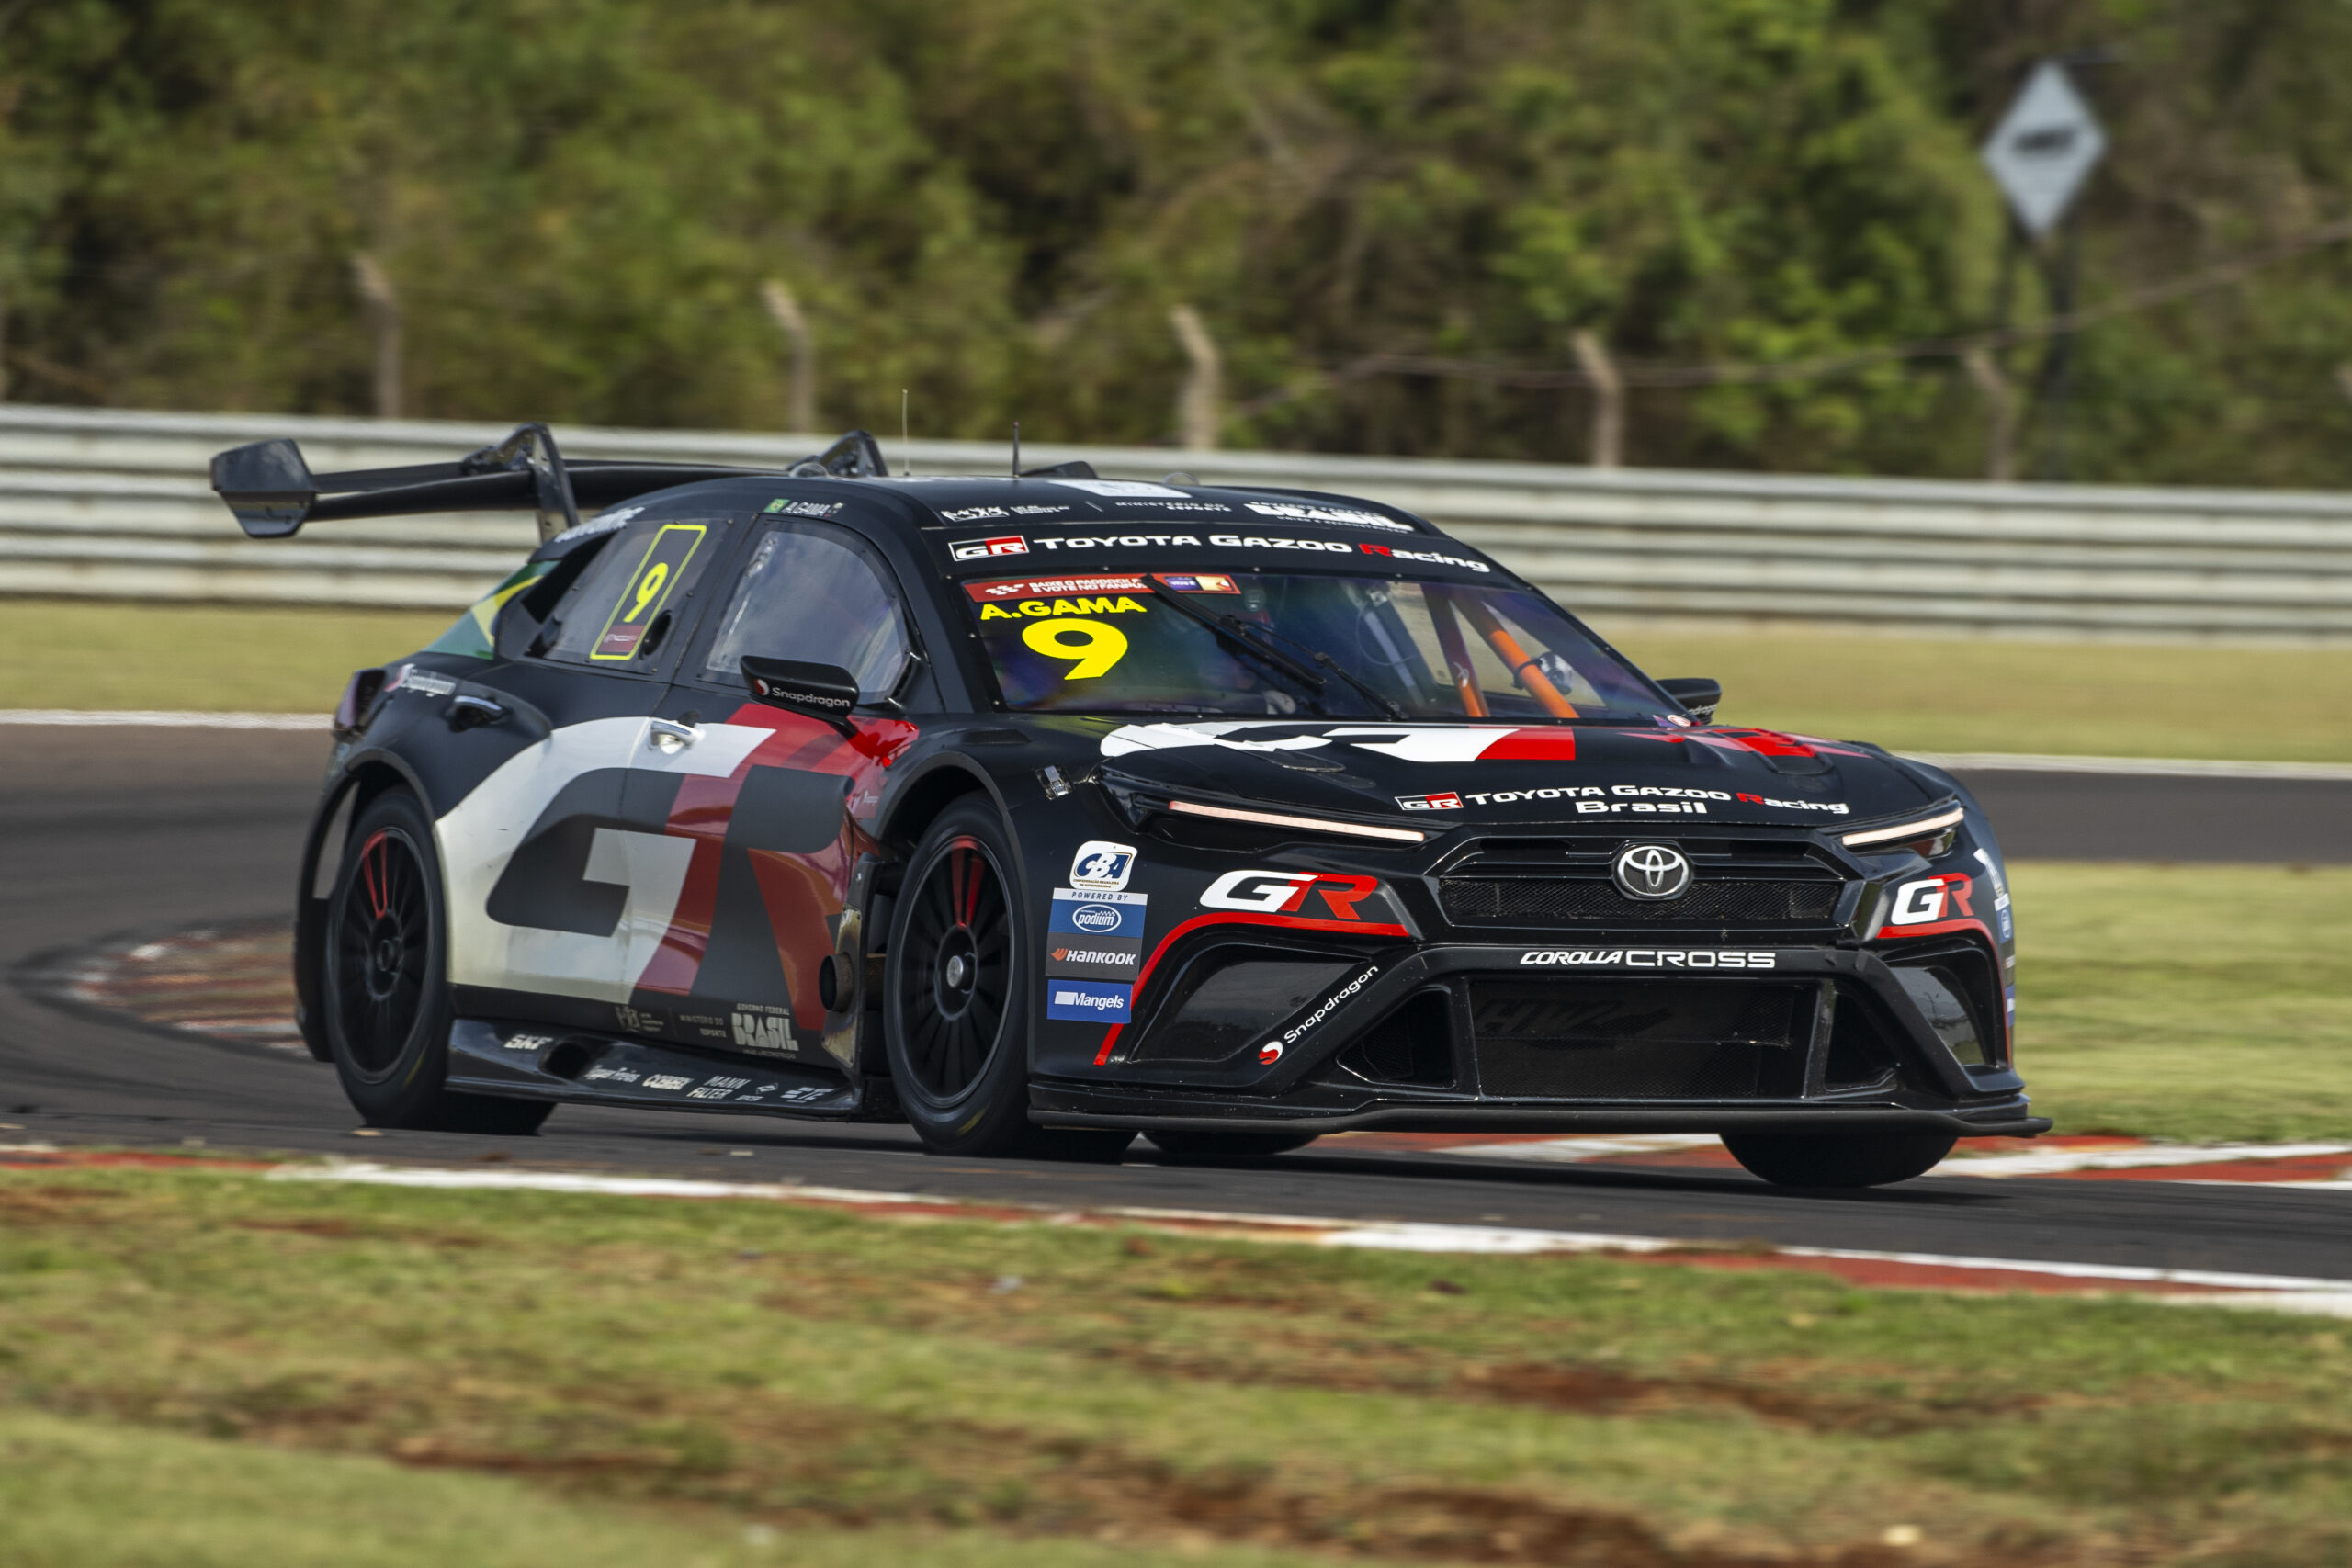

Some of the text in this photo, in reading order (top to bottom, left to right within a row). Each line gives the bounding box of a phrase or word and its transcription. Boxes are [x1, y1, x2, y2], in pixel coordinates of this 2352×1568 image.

[956, 542, 1028, 559] GR
[1033, 535, 1202, 549] TOYOTA
[1358, 543, 1491, 573] Racing
[622, 562, 669, 623] 9
[980, 597, 1148, 620] A.GAMA
[1022, 618, 1128, 681] 9
[772, 687, 851, 707] Snapdragon
[1465, 786, 1606, 805] TOYOTA
[1736, 792, 1850, 815] Racing
[1575, 801, 1708, 814] Brasil
[1076, 853, 1130, 879] CBA
[1071, 891, 1113, 900] POWERED
[1200, 870, 1378, 920] GR
[1891, 872, 1974, 925] GR
[1078, 912, 1115, 926] podium
[1520, 950, 1777, 968] COROLLA CROSS
[1072, 992, 1125, 1010] Mangels
[1283, 965, 1379, 1043] Snapdragon
[504, 1034, 553, 1049] SKF
[731, 1012, 799, 1051] BRASIL
[686, 1087, 734, 1100] FILTER
[704, 1076, 752, 1089] MANN
